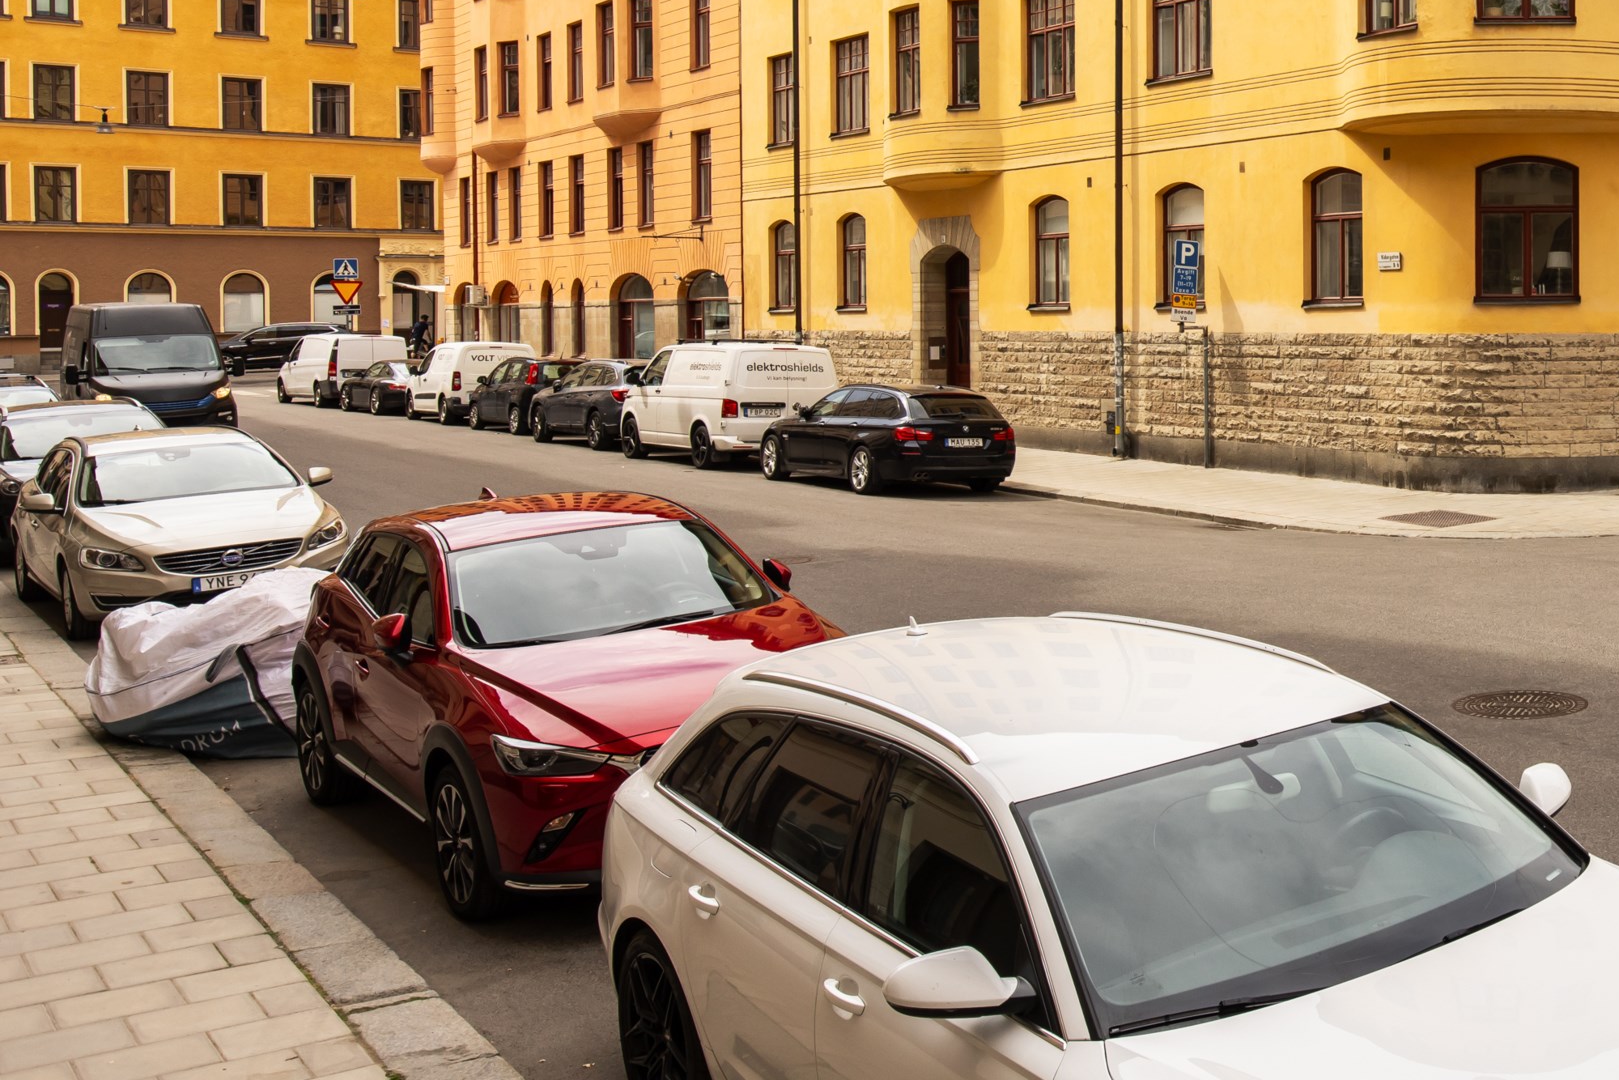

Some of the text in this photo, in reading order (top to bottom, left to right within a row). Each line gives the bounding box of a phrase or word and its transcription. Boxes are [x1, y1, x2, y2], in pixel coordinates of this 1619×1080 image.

[1181, 243, 1195, 264] P
[1177, 268, 1195, 276] Avgift
[746, 362, 824, 373] elektroshields
[206, 575, 235, 589] YNE
